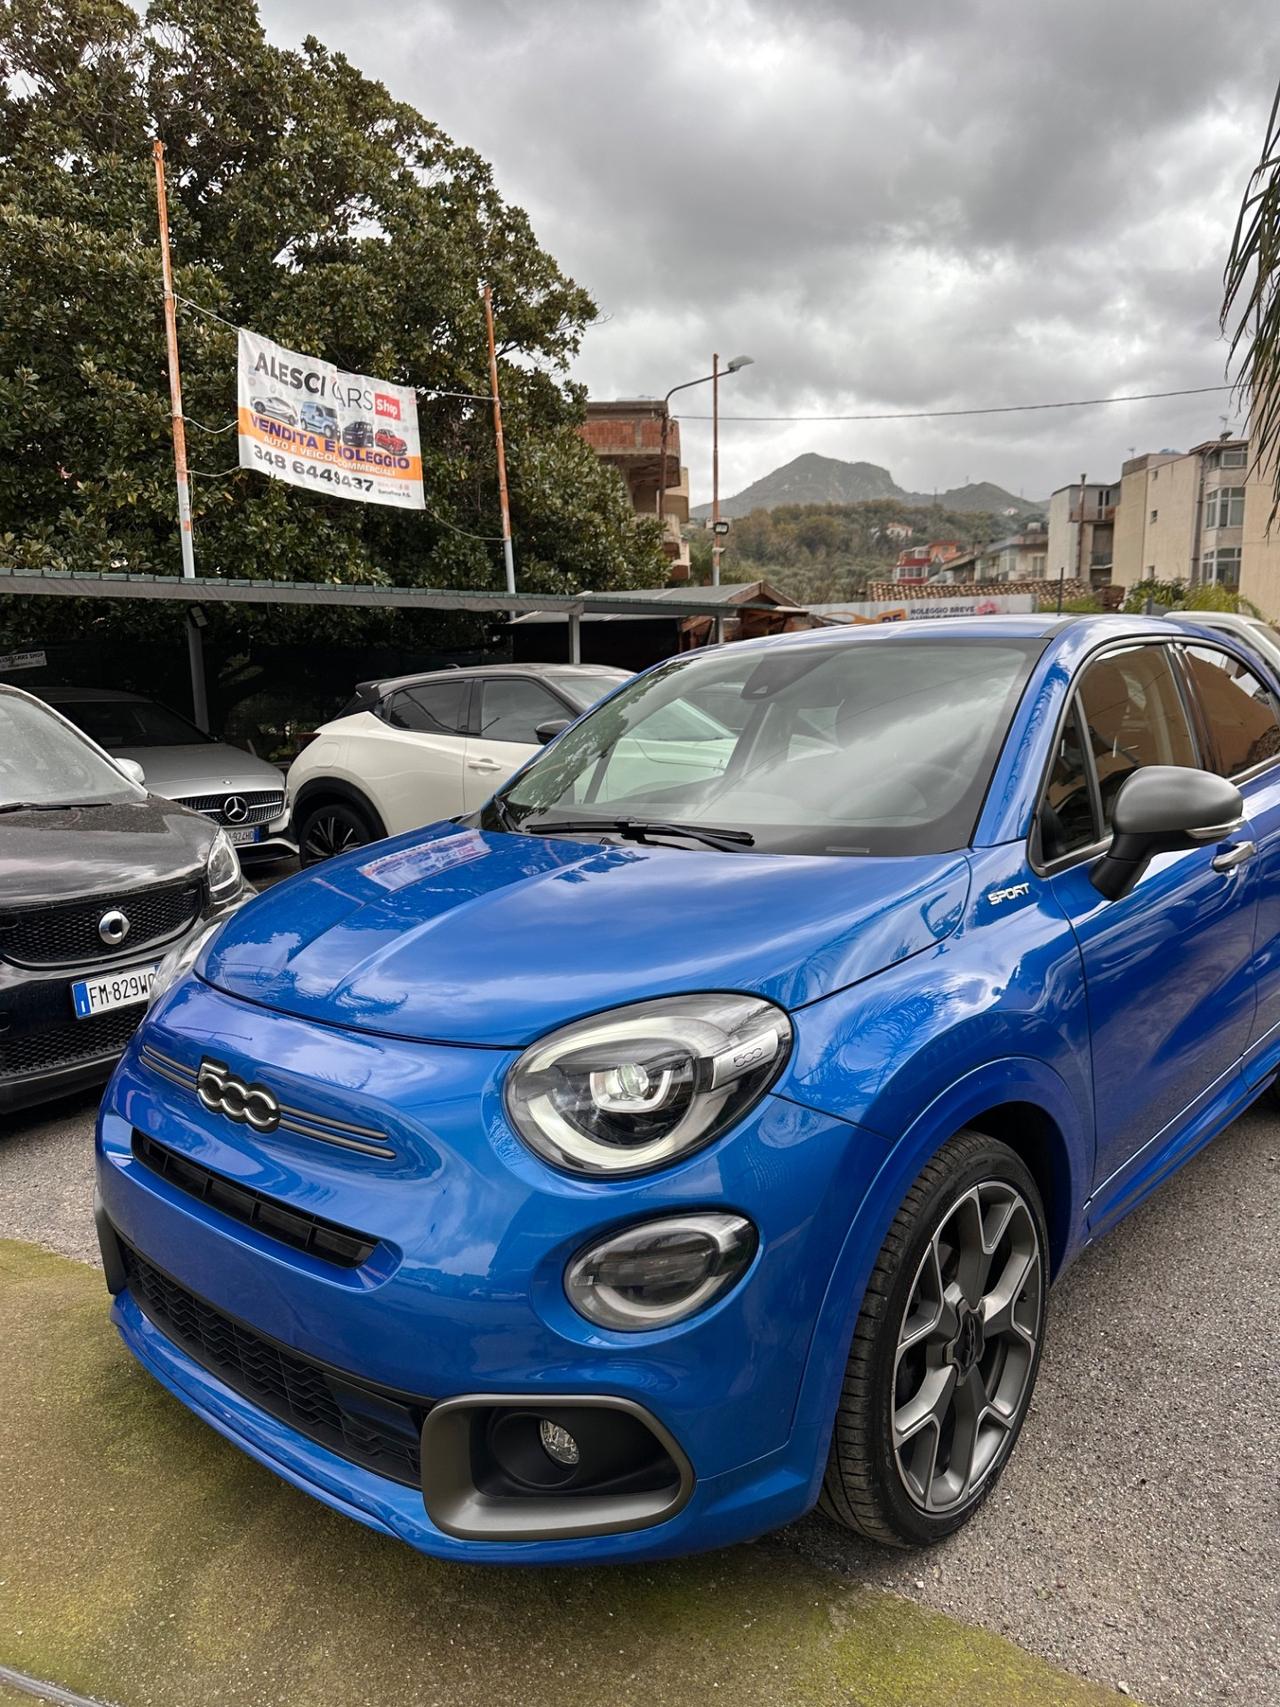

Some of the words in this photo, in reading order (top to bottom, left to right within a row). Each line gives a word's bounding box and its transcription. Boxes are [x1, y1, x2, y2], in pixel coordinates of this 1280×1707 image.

[254, 351, 325, 397] ALESCI
[376, 398, 399, 417] Shop
[250, 415, 319, 450] VENDITA
[324, 439, 336, 452] E
[263, 435, 289, 450] AUTO
[253, 444, 287, 470] 348
[950, 606, 975, 614] BREVE
[987, 882, 1029, 905] SPORT
[734, 1047, 763, 1067] 500
[197, 1062, 277, 1127] 500
